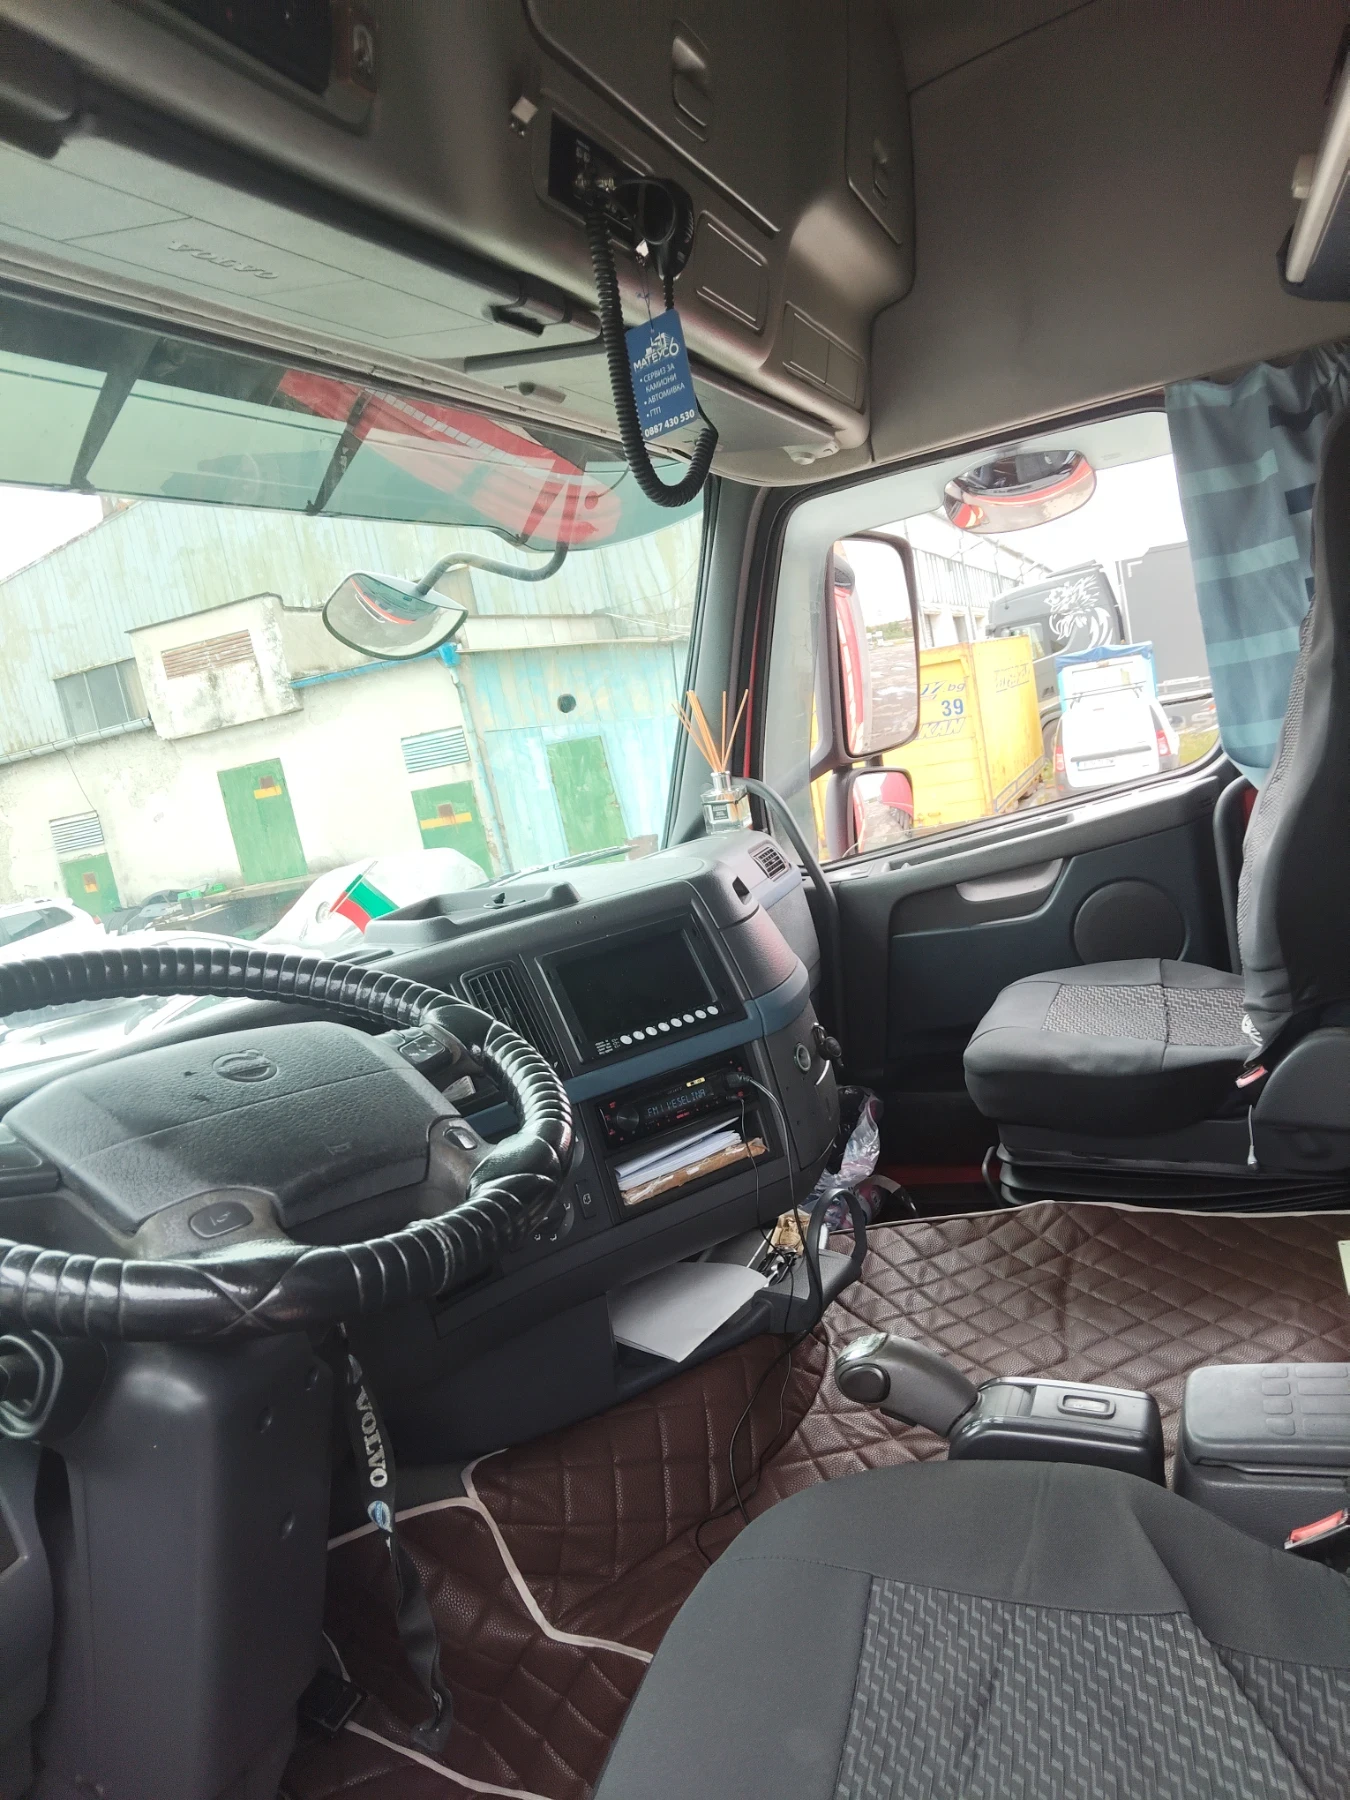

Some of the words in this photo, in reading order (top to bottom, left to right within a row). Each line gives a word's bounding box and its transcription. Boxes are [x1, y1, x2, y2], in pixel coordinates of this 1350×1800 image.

[643, 366, 666, 383] СЕРВИЗ
[666, 362, 676, 373] ЗА
[645, 373, 677, 393] КАМИОНИ
[648, 382, 685, 404] АВТОМИВКА
[650, 406, 661, 418] ГТП
[644, 422, 663, 438] 0887
[664, 415, 679, 429] 430
[680, 408, 695, 423] 530
[941, 698, 964, 717] 39
[666, 1089, 706, 1110] VESELINA
[356, 1385, 388, 1488] VOLVO
